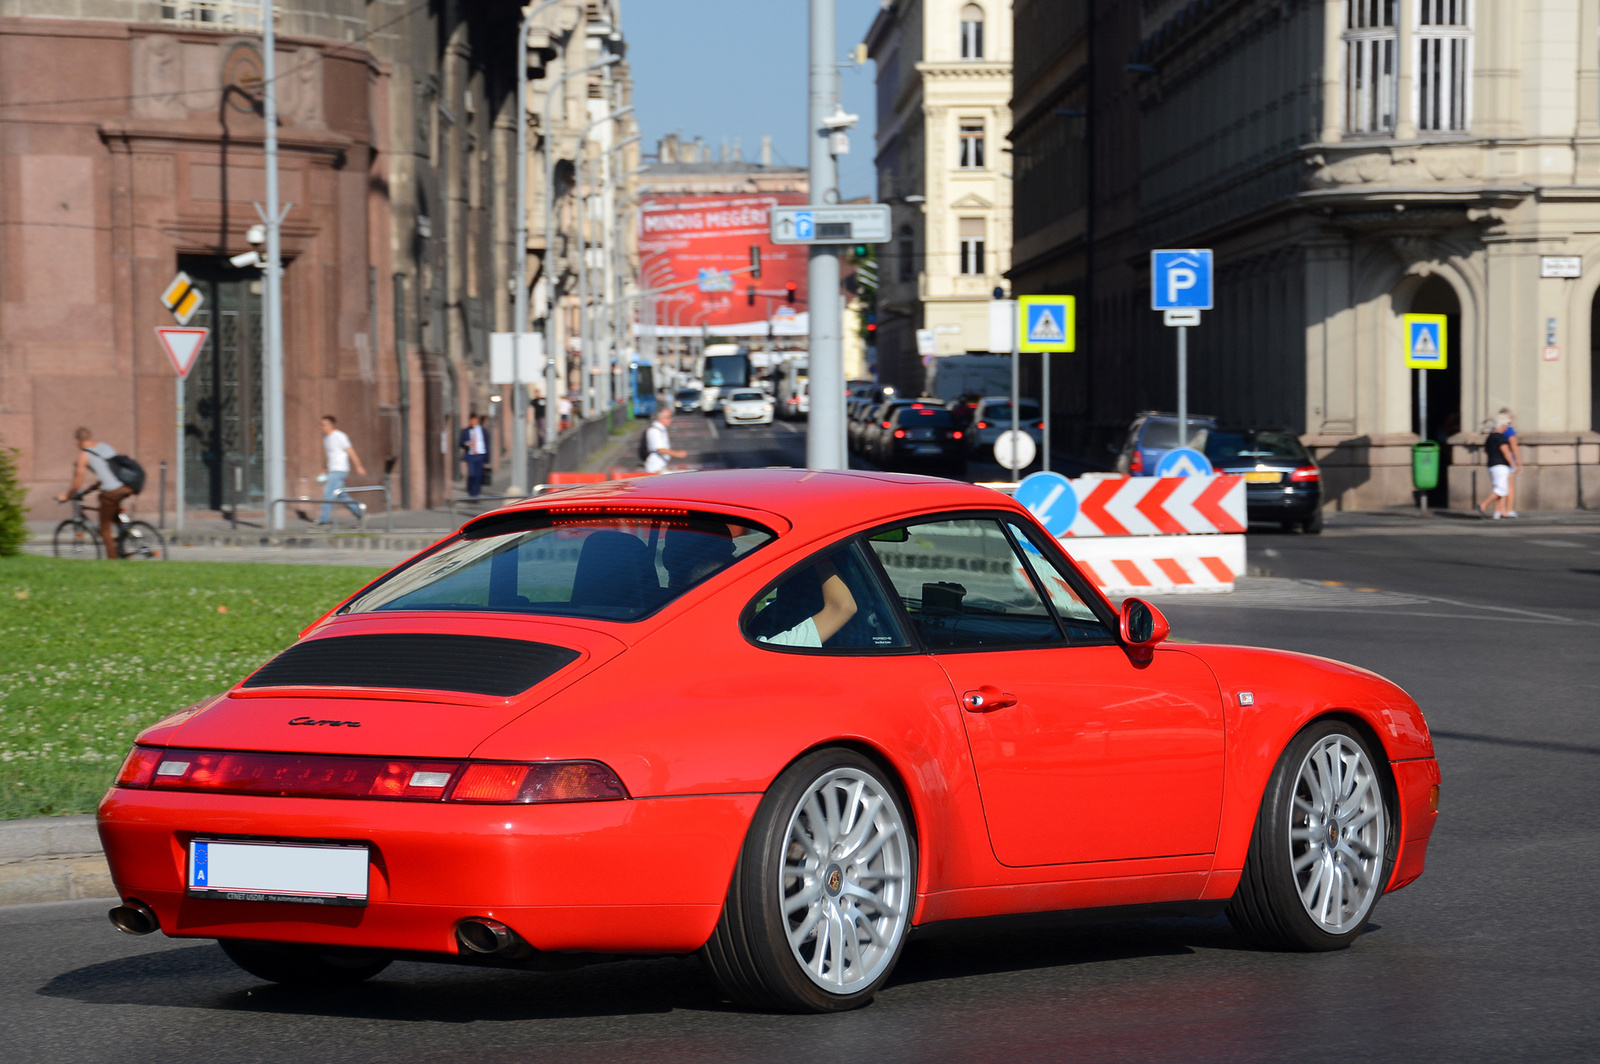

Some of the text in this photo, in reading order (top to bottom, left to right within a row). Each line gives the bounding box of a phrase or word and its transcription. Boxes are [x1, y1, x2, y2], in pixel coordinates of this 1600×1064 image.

[644, 212, 704, 232] MINDIG
[1168, 267, 1197, 303] P
[288, 716, 361, 728] Carrera
[196, 869, 205, 880] A
